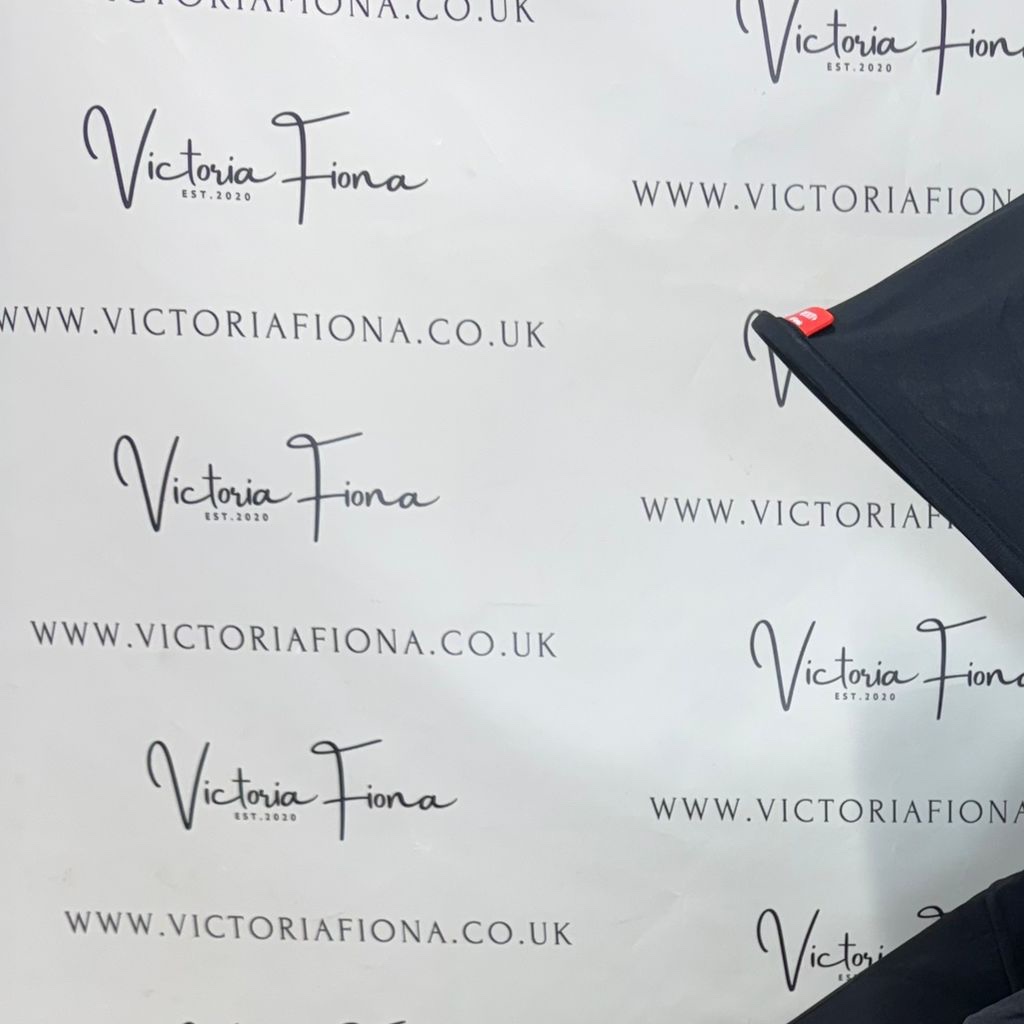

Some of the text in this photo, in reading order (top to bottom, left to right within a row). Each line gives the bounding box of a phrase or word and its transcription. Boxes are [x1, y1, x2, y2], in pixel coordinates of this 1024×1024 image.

[735, 0, 916, 84] Victoria
[827, 62, 892, 72] EST.2020
[83, 105, 428, 225] Victoria Fiona
[182, 189, 251, 201] EST.2020
[0, 306, 546, 349] WWW.VICTORIAFIONA.CO.UK
[113, 432, 440, 543] Victoria Fiona
[205, 512, 268, 521] EST.2020
[640, 496, 955, 529] WWW.VICTORIAF
[30, 620, 557, 658] WWW.VICTORIAFIONA.CO.UK
[750, 619, 919, 712] Victoria
[835, 692, 895, 701] EST.2020
[146, 739, 458, 841] Victoria Fiona
[234, 812, 296, 821] EST.2020
[64, 911, 572, 945] WWW.VICTORIAFIONA.CO.UK
